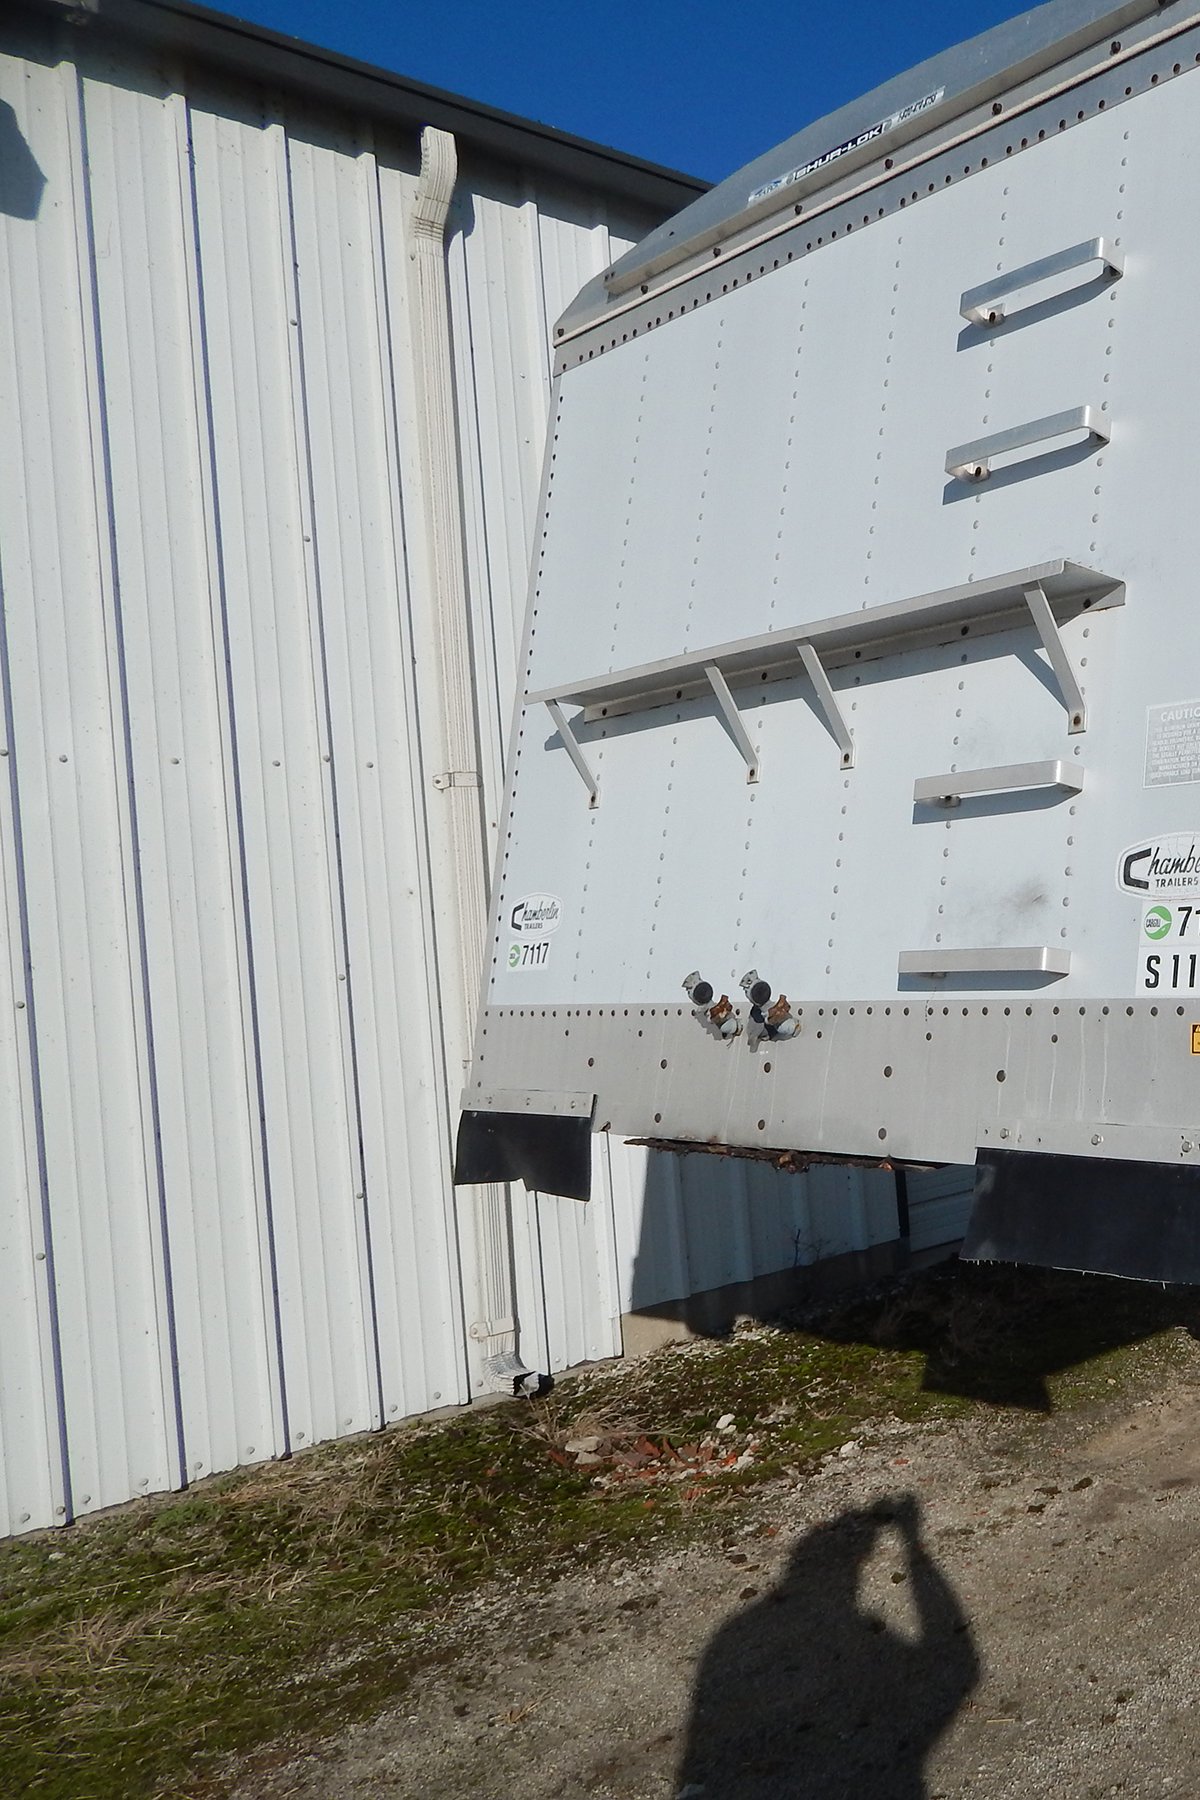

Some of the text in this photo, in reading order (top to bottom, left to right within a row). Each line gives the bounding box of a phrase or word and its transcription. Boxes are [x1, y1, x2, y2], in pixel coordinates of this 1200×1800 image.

[1155, 877, 1199, 888] TRAILERS
[511, 901, 559, 931] Chamberlin
[522, 942, 549, 965] 7117
